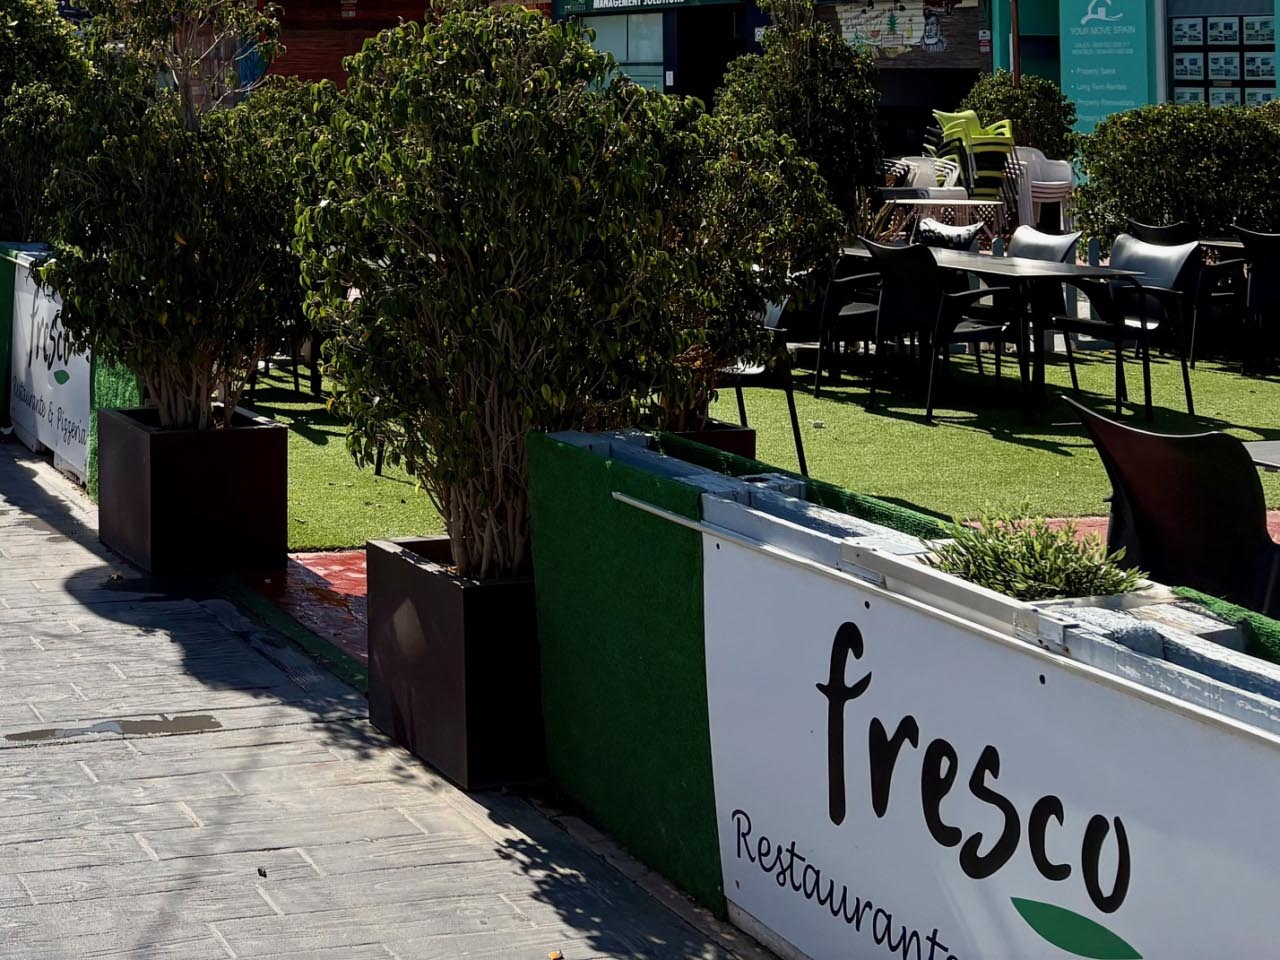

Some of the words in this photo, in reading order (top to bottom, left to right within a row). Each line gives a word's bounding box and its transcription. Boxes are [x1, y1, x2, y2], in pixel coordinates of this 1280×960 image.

[47, 401, 54, 425] &
[816, 620, 1132, 914] fresco
[731, 808, 959, 960] Restaurant
